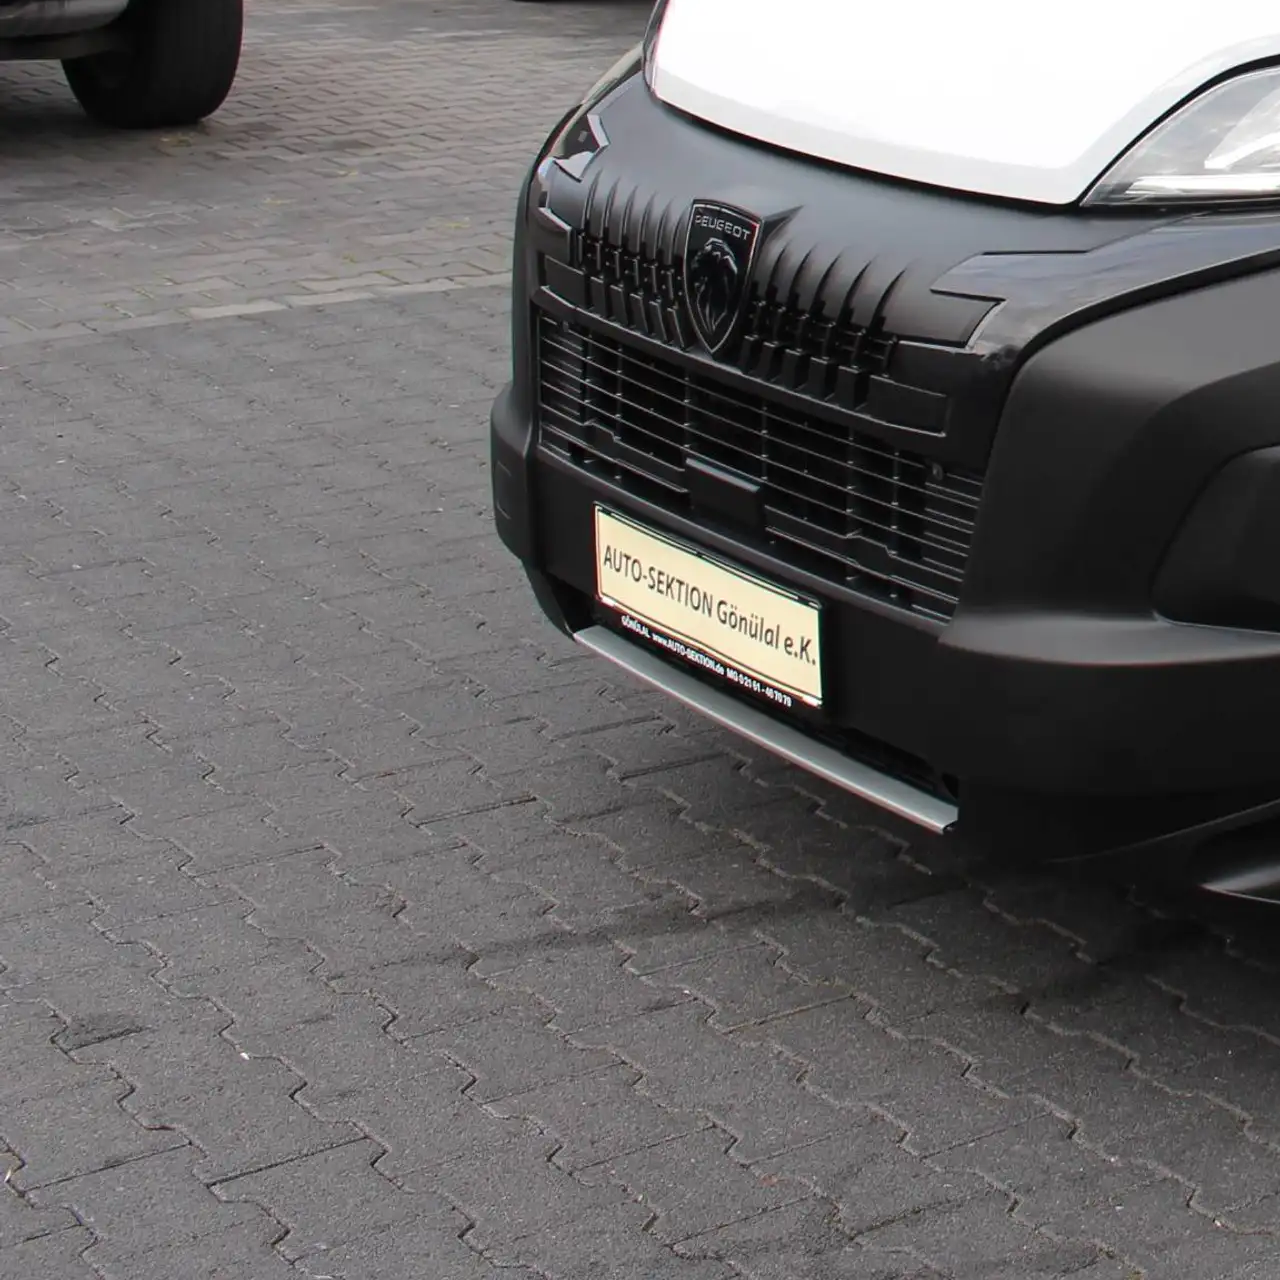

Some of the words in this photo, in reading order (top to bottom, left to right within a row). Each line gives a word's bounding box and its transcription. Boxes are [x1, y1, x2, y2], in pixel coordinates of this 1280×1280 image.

[694, 214, 751, 241] PEUGEOT
[603, 545, 714, 618] AUTO-SEKTION
[716, 600, 780, 650] Gönülal
[783, 635, 817, 666] e.K.
